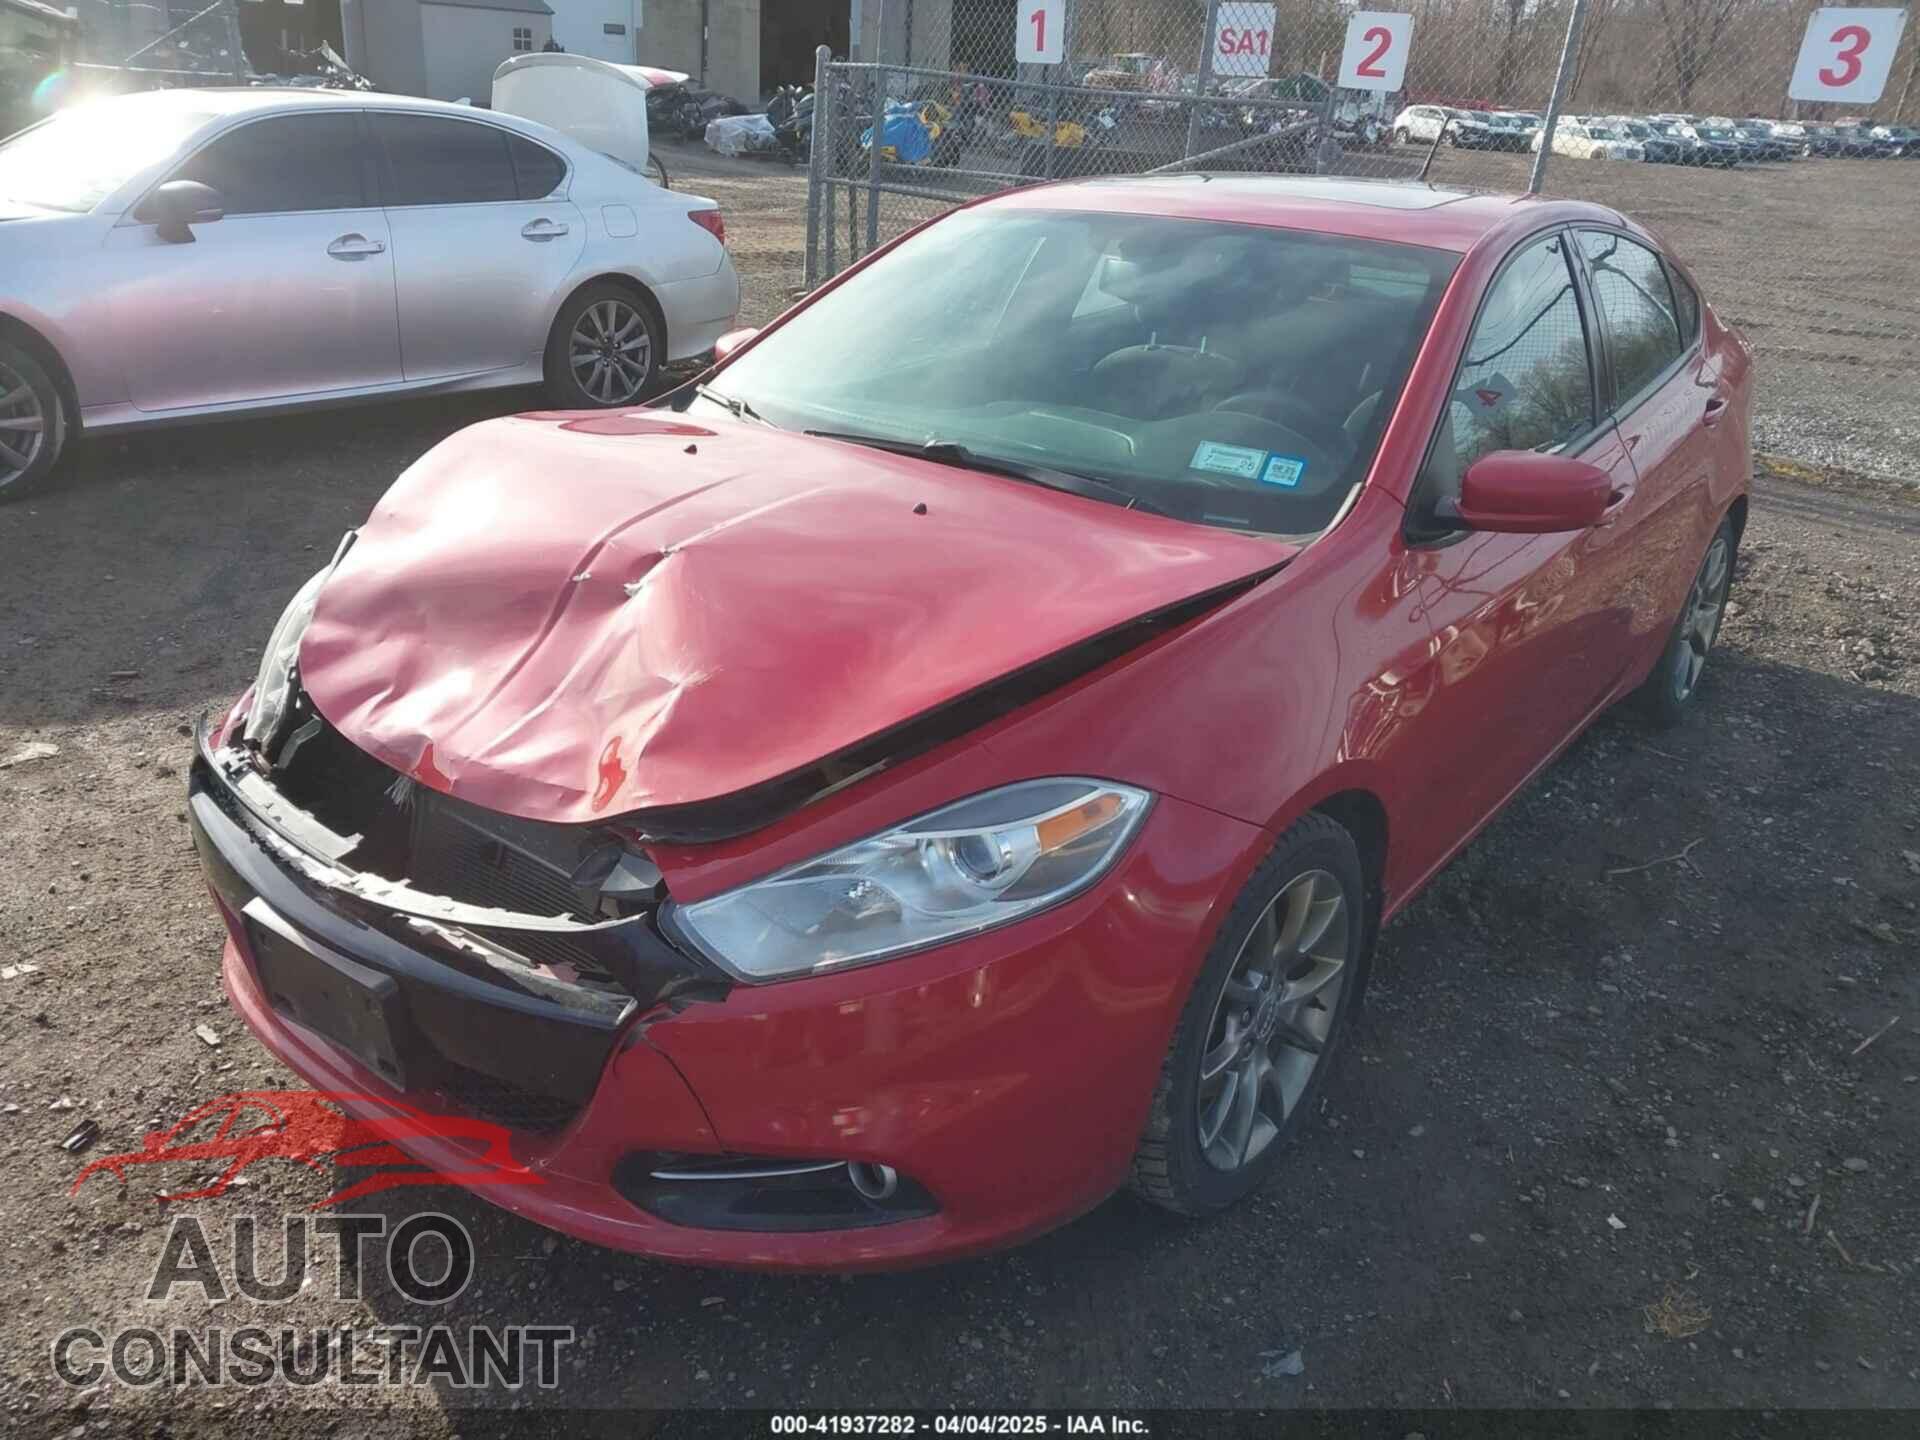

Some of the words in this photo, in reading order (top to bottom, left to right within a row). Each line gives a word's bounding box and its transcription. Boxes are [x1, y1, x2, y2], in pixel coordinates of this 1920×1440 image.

[1031, 9, 1045, 51] 1
[1218, 27, 1268, 55] SA1
[1356, 26, 1392, 78] 2
[1818, 25, 1871, 87] 3
